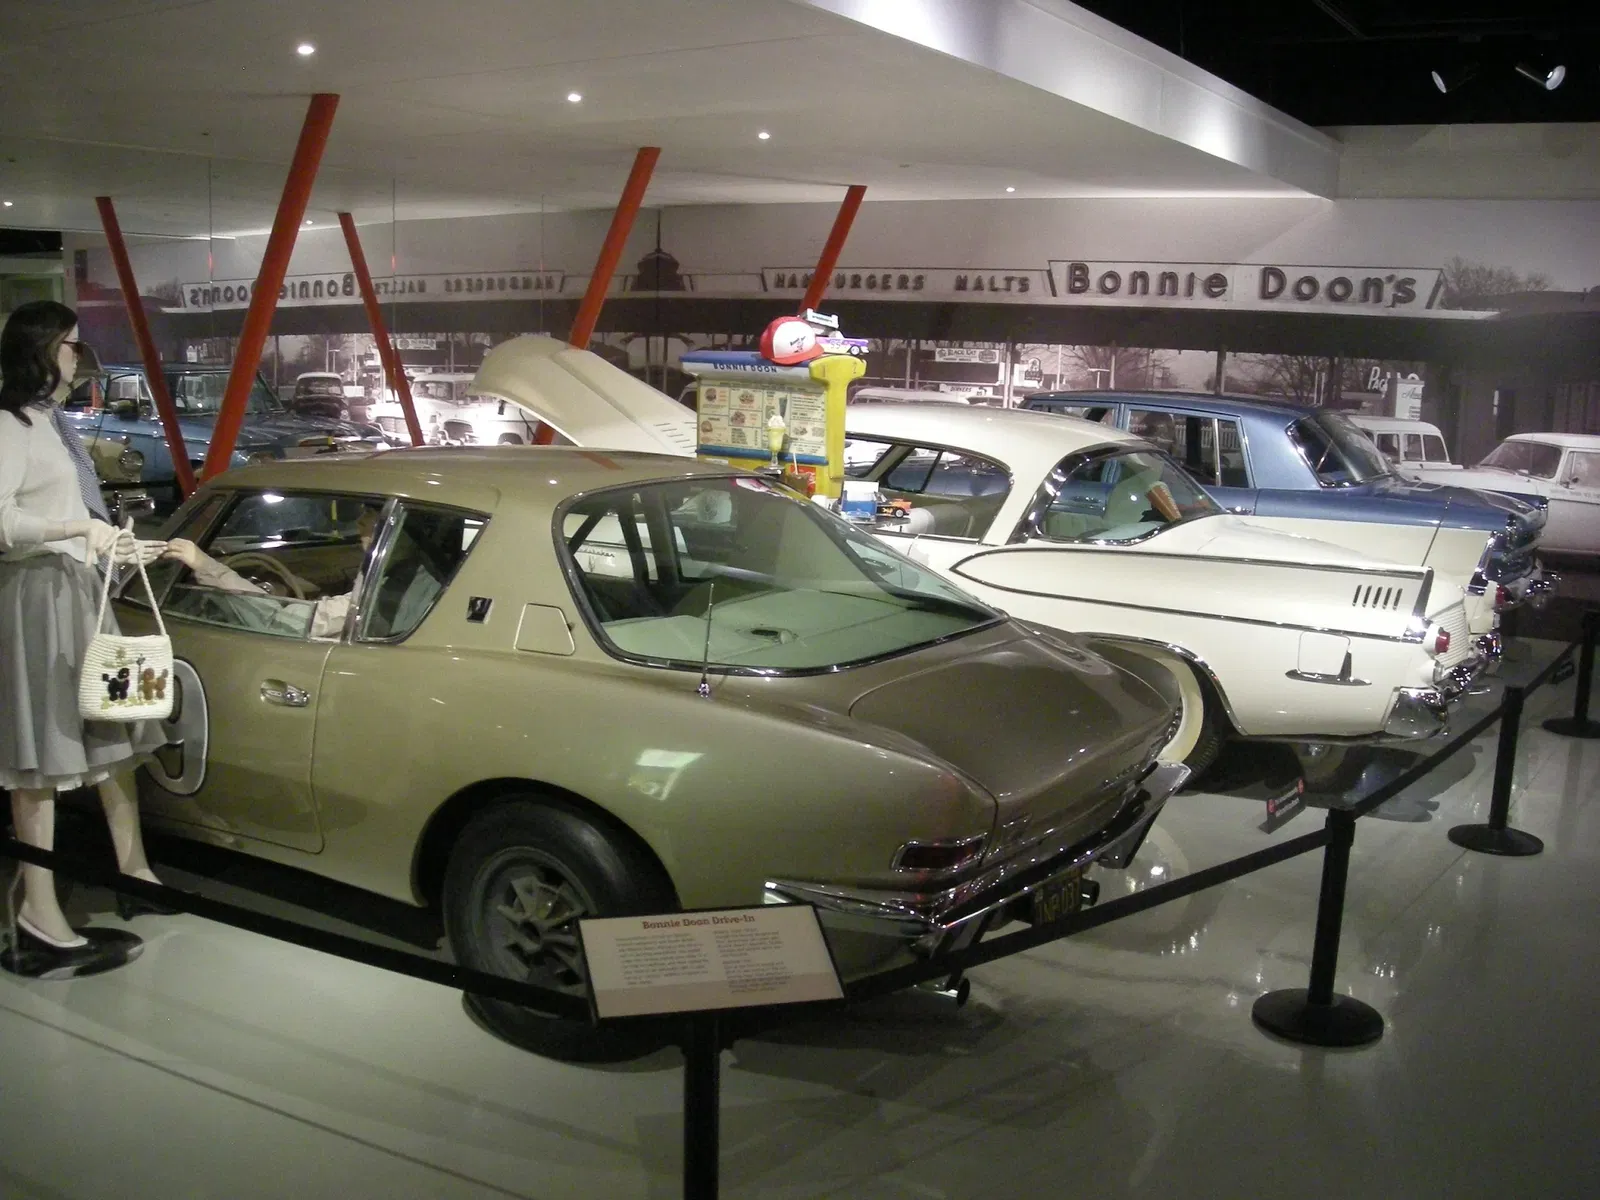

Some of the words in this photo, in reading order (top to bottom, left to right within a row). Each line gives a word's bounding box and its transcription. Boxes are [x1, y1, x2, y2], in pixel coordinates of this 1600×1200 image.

[773, 272, 926, 291] HAMURGERS
[954, 274, 1031, 293] MALTS
[1066, 262, 1230, 298] Bonnie
[1259, 265, 1417, 308] Doon's
[713, 361, 747, 371] BONNIE
[750, 364, 777, 373] DOON
[642, 919, 680, 930] Bonnie
[682, 918, 710, 927] Doon
[712, 914, 756, 925] Drive-In
